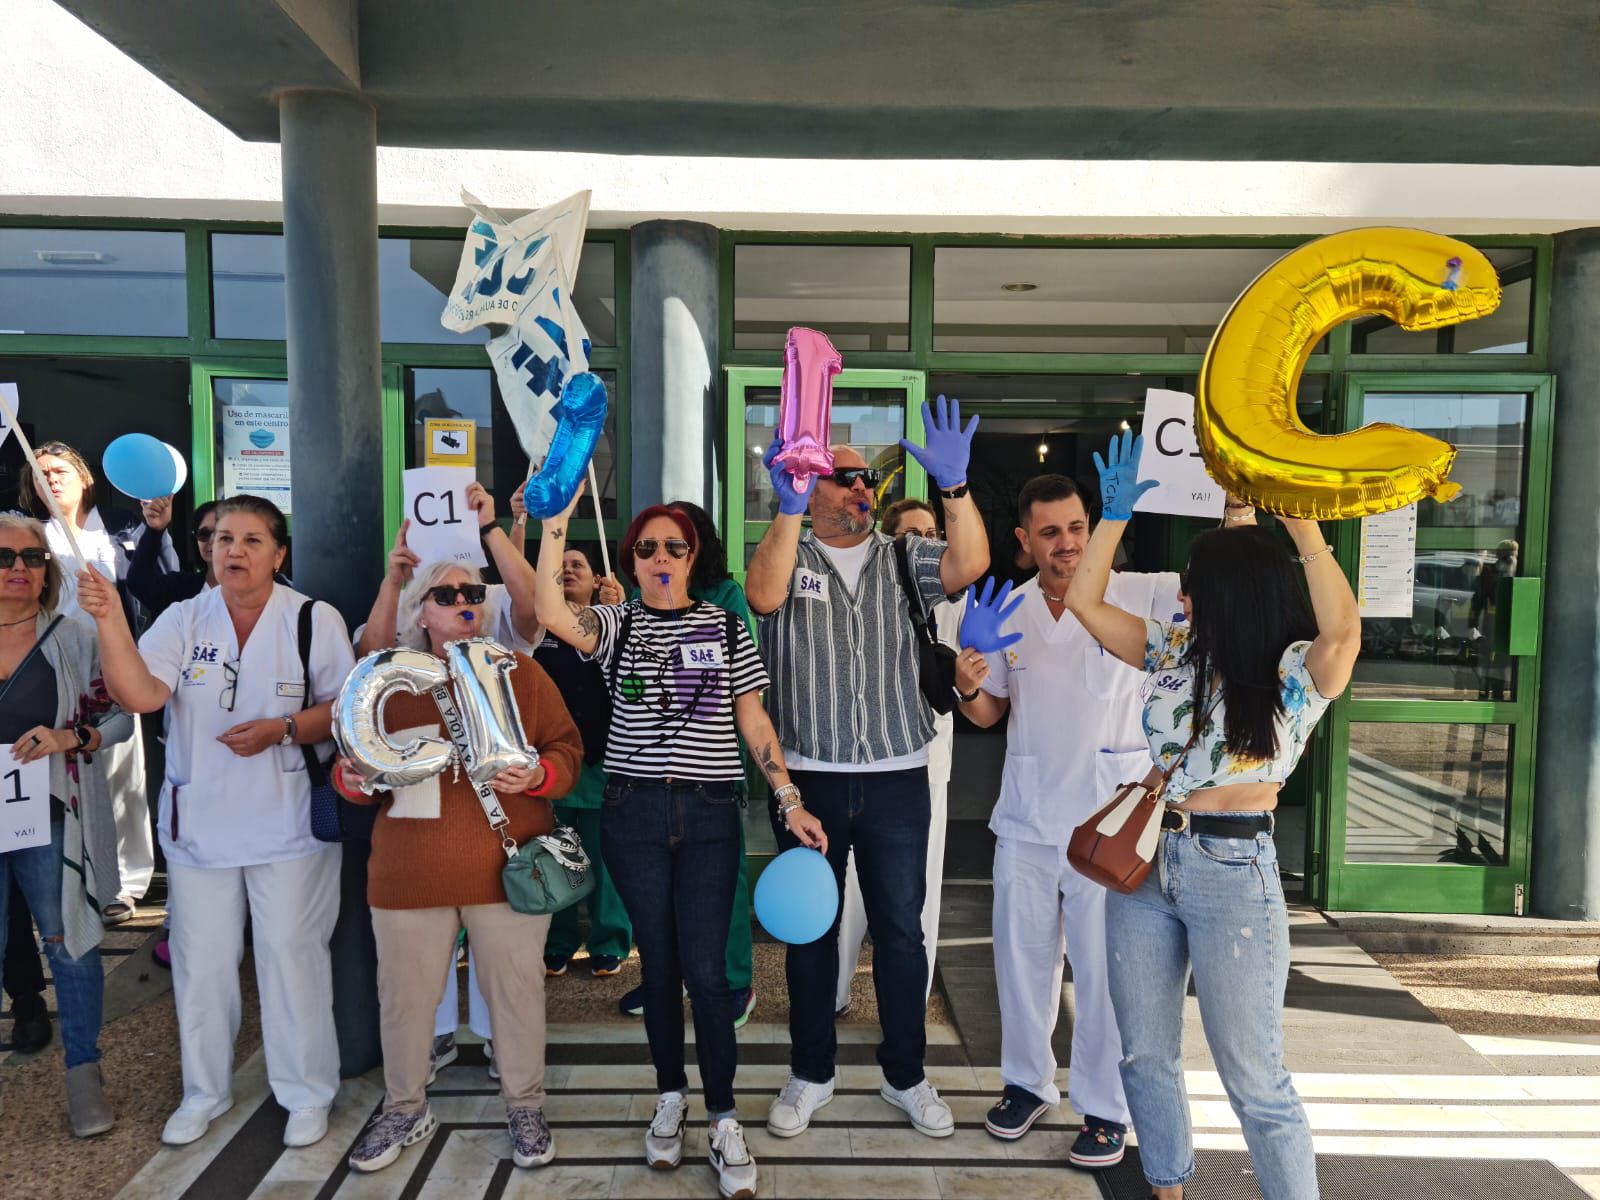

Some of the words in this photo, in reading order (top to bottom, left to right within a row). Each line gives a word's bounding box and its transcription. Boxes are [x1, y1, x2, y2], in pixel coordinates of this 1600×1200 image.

[227, 410, 243, 418] Uso
[244, 410, 254, 418] de
[246, 419, 263, 427] este
[1155, 417, 1203, 457] C
[413, 489, 463, 527] C1
[801, 575, 822, 594] SAE
[192, 645, 218, 662] SAE
[690, 648, 715, 662] SAE
[444, 706, 465, 739] LOLA
[14, 827, 36, 838] YA!!
